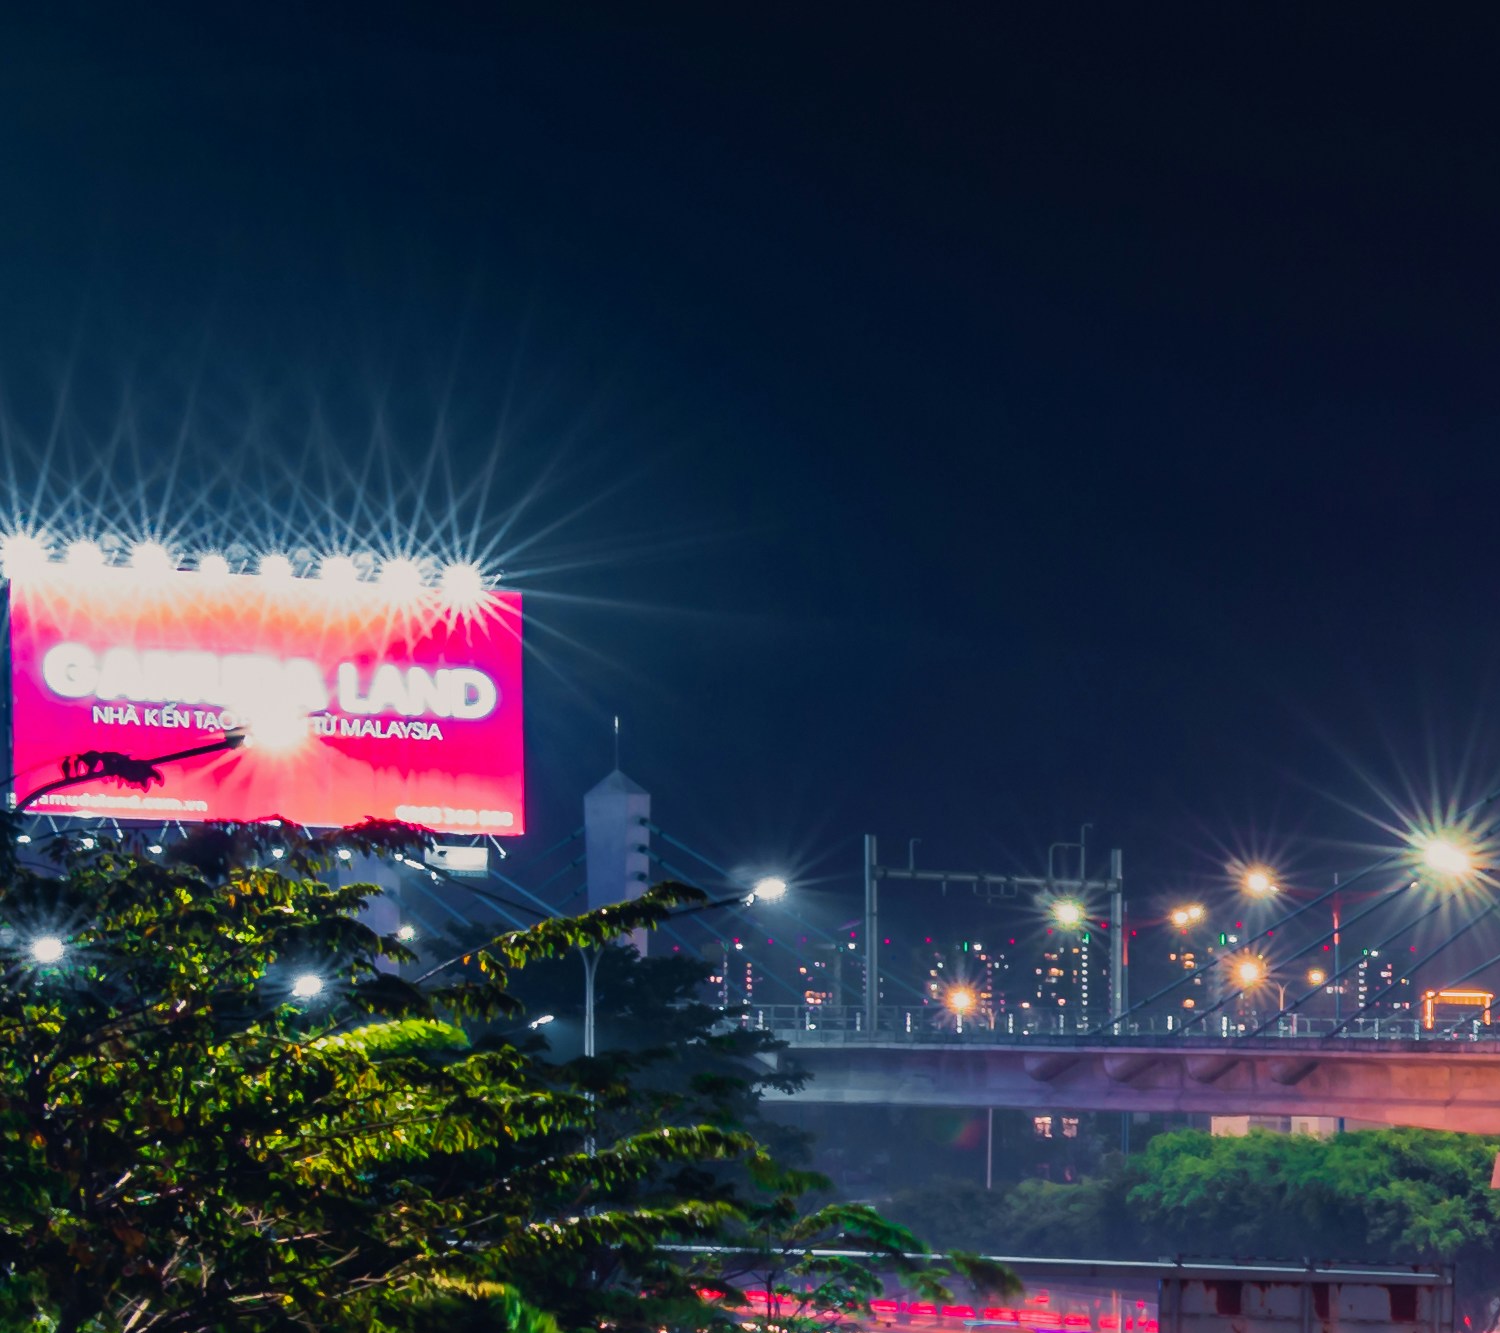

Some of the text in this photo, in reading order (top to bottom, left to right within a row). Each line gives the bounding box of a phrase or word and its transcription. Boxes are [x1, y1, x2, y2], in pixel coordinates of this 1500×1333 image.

[338, 661, 498, 720] LAND
[92, 704, 140, 726] NHÀ
[144, 702, 190, 728] KẾN
[340, 718, 444, 741] MALAYSIA
